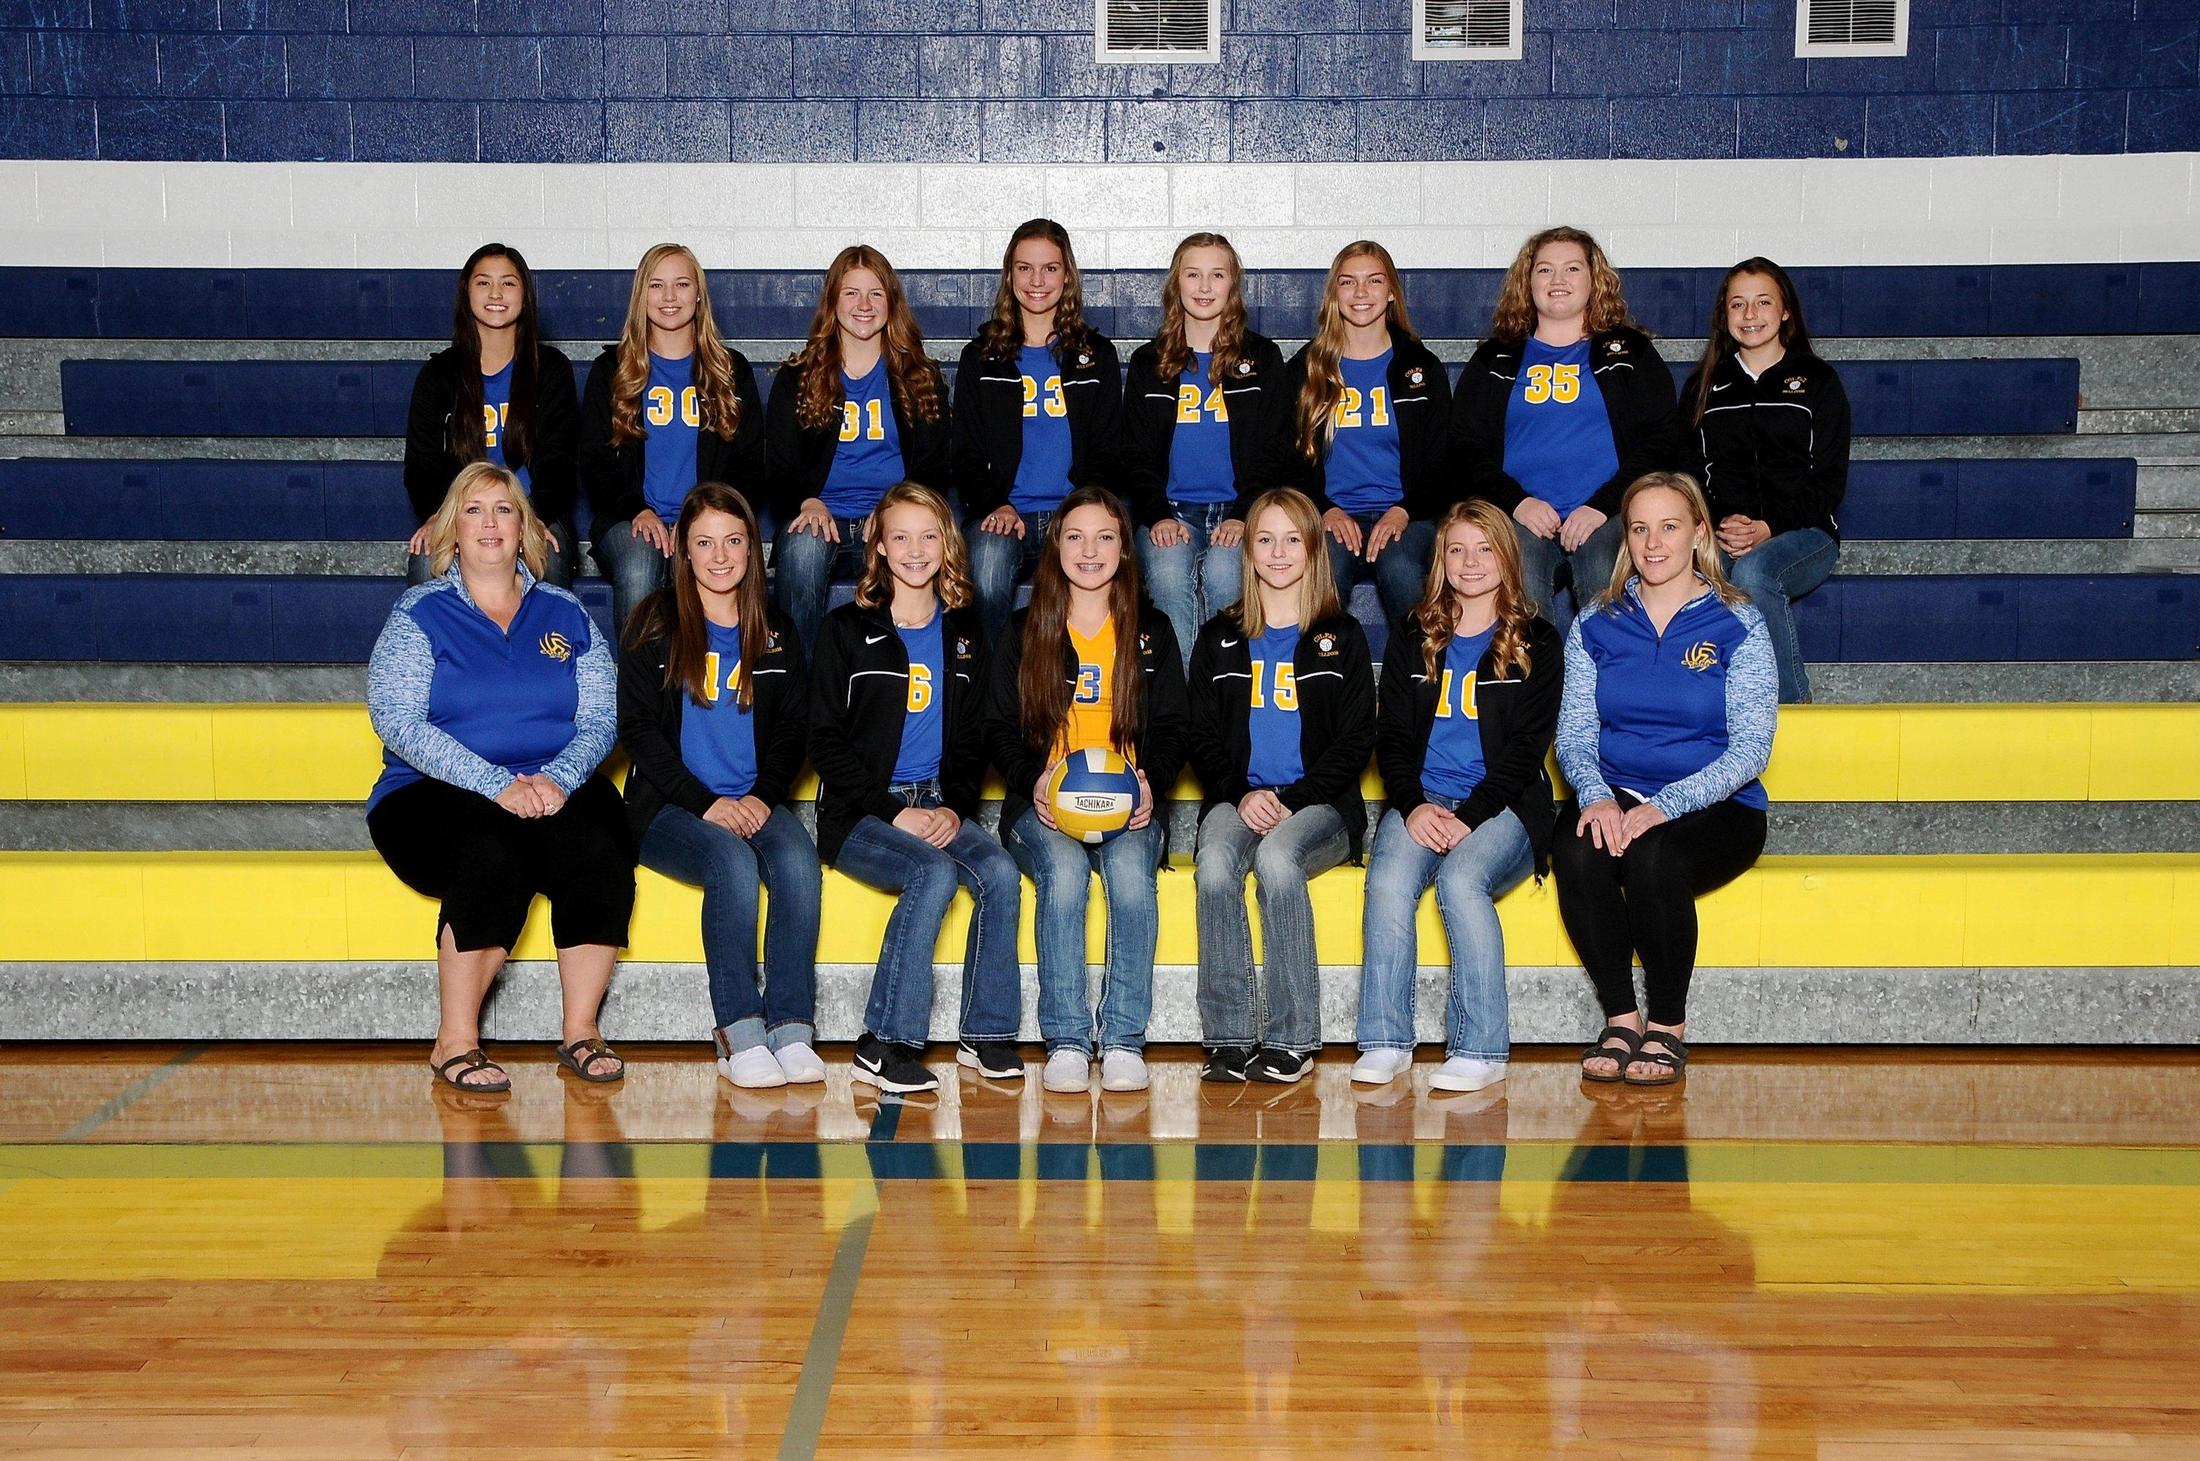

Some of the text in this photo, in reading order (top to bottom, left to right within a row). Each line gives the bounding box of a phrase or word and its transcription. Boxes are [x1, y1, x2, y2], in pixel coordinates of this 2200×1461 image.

[1021, 375, 1068, 417] 23
[1176, 383, 1229, 424] 24
[1524, 363, 1580, 404] 35
[483, 402, 510, 448] 2
[647, 386, 700, 427] 30
[838, 398, 885, 442] 31
[1335, 386, 1389, 428] 21
[906, 662, 932, 713] 6
[1075, 663, 1101, 704] 3
[1251, 660, 1299, 712] 15
[1075, 796, 1115, 809] TACHIKARA
